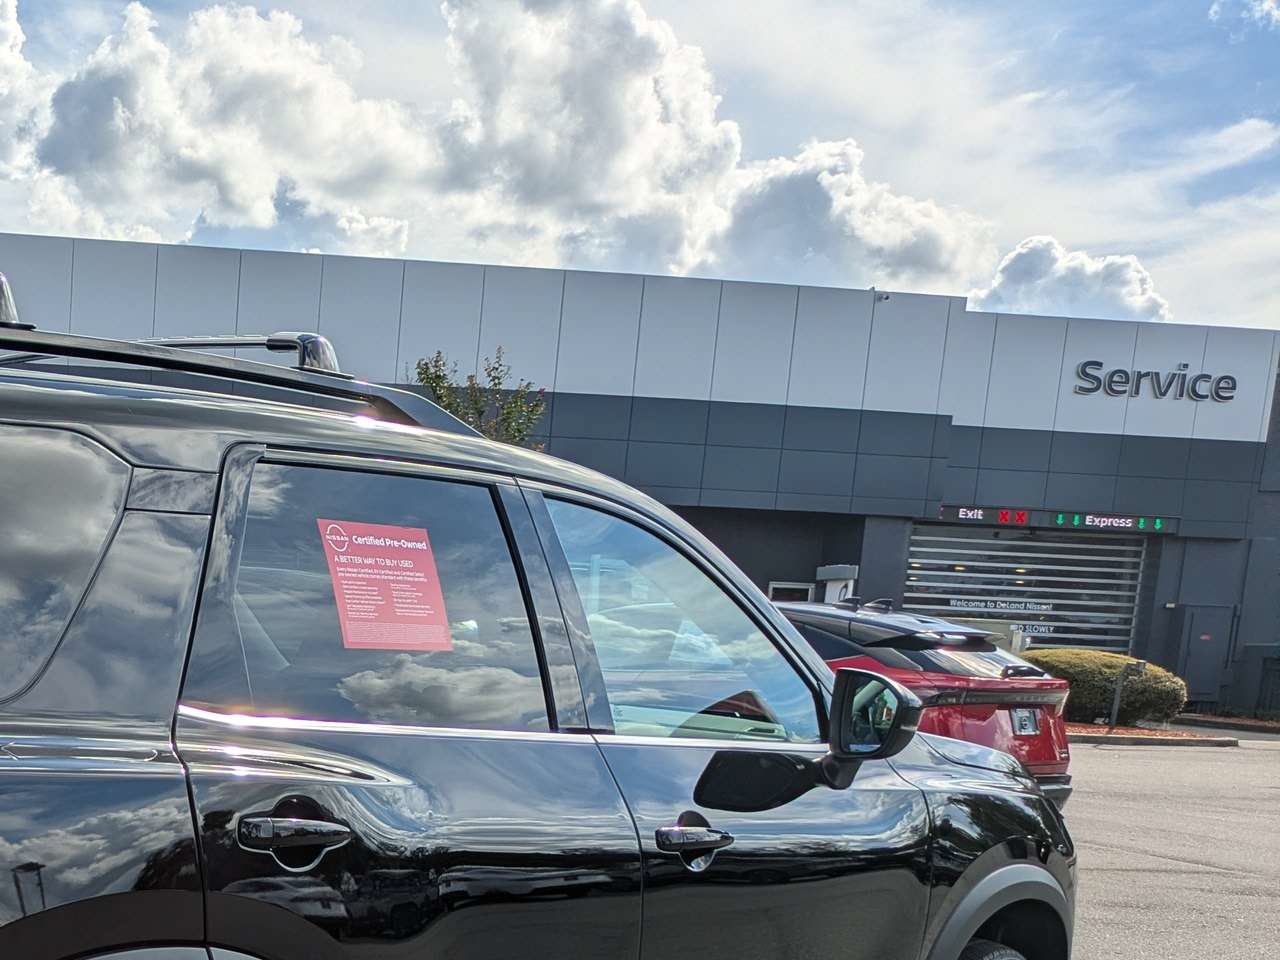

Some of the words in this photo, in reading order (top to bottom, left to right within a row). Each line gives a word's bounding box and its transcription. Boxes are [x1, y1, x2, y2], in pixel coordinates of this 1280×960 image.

[1075, 360, 1237, 402] Service
[958, 508, 984, 520] Exit
[1085, 515, 1133, 527] Express
[352, 535, 385, 546] Certified
[386, 538, 427, 550] Pre-Owned
[340, 555, 362, 564] BETTER
[363, 557, 376, 565] WAY
[376, 558, 385, 566] TO
[385, 558, 397, 567] BUY
[398, 560, 414, 568] USED
[949, 599, 985, 608] Welcome
[996, 601, 1024, 609] DeLand
